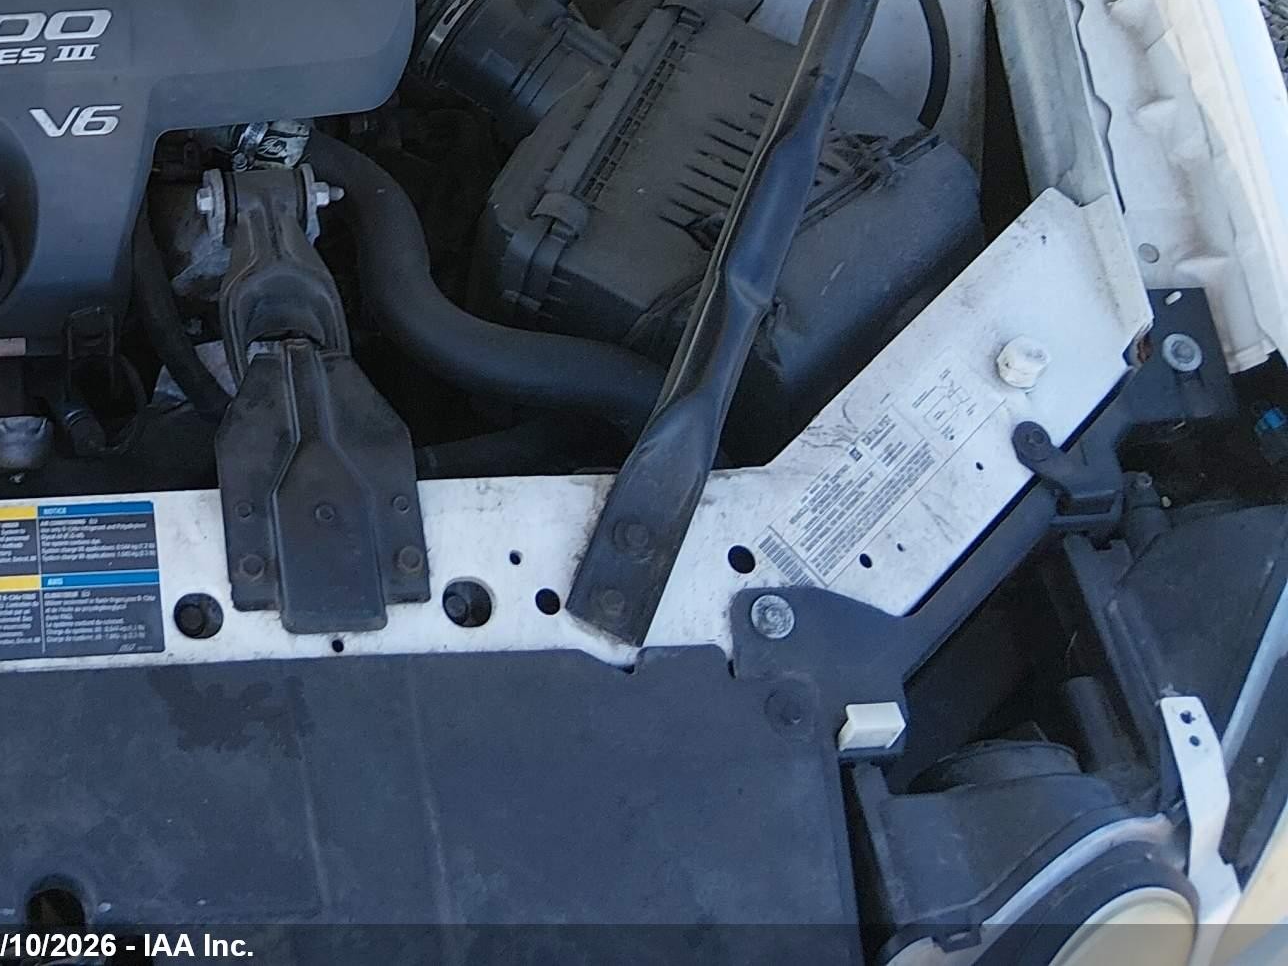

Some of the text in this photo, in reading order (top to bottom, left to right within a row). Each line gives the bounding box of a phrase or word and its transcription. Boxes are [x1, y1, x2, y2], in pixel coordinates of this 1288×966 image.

[52, 43, 100, 62] III
[28, 105, 122, 138] V6
[43, 507, 67, 515] NOTICE
